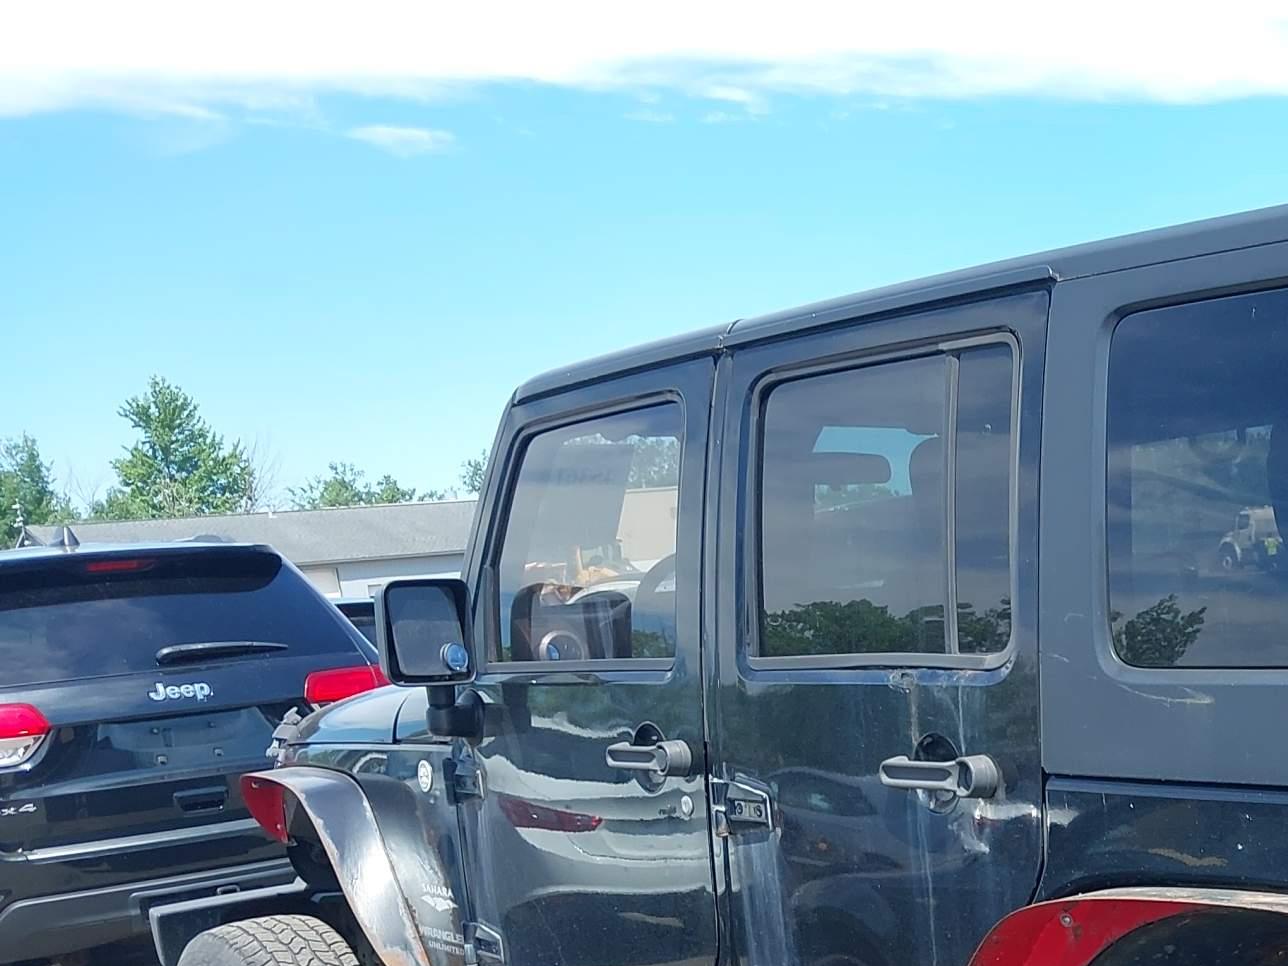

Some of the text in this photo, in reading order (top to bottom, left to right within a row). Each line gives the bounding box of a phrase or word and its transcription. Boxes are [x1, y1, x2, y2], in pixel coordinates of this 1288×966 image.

[148, 682, 212, 702] Jeep
[421, 883, 454, 898] SAHARA
[419, 925, 464, 944] WRANGLE
